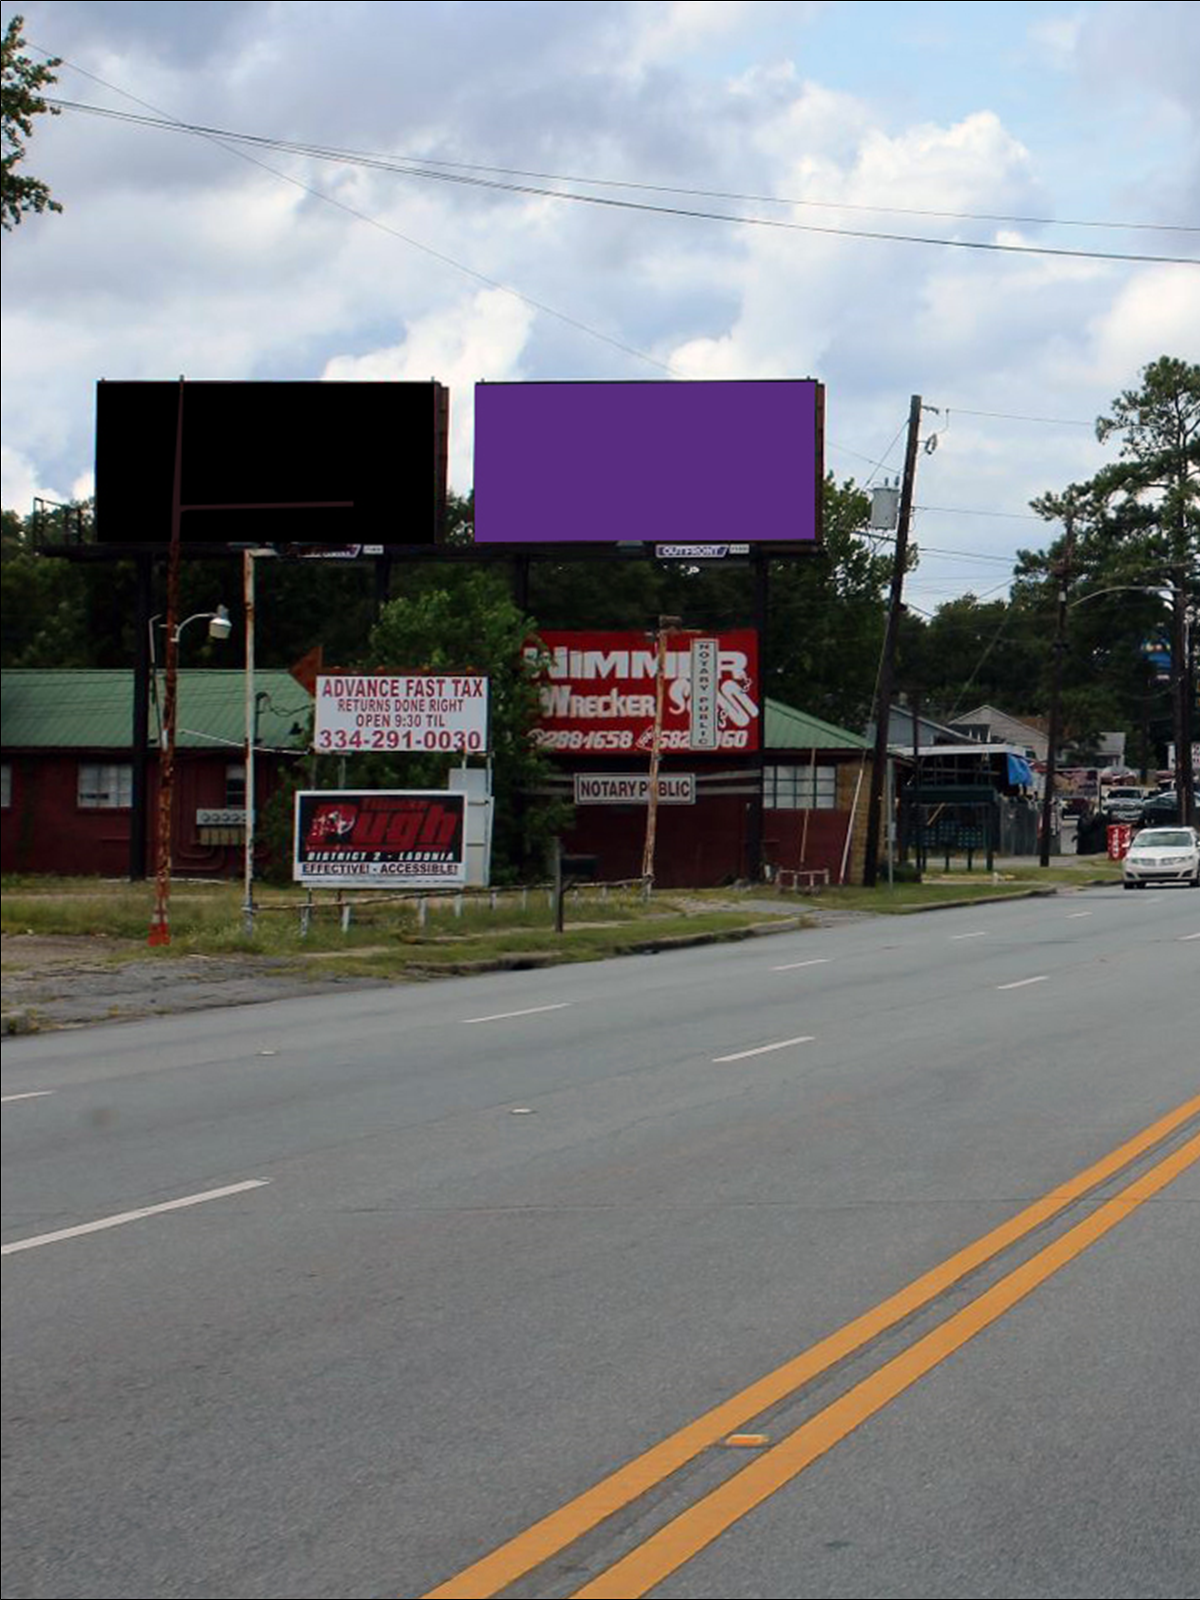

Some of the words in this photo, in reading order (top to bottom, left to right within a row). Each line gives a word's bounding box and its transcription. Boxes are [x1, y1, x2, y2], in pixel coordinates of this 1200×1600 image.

[322, 679, 399, 698] ADVANCE
[406, 679, 446, 698] FAST
[452, 679, 483, 698] TAX
[338, 699, 391, 712] RETURNS
[395, 699, 425, 712] DONE
[429, 699, 464, 712] RIGHT
[356, 714, 391, 728] OPEN
[395, 714, 422, 728] 9:30
[426, 714, 446, 728] TIL
[319, 729, 482, 750] 334-291-0030
[581, 780, 636, 797] NOTARY
[639, 780, 690, 797] PBLIC
